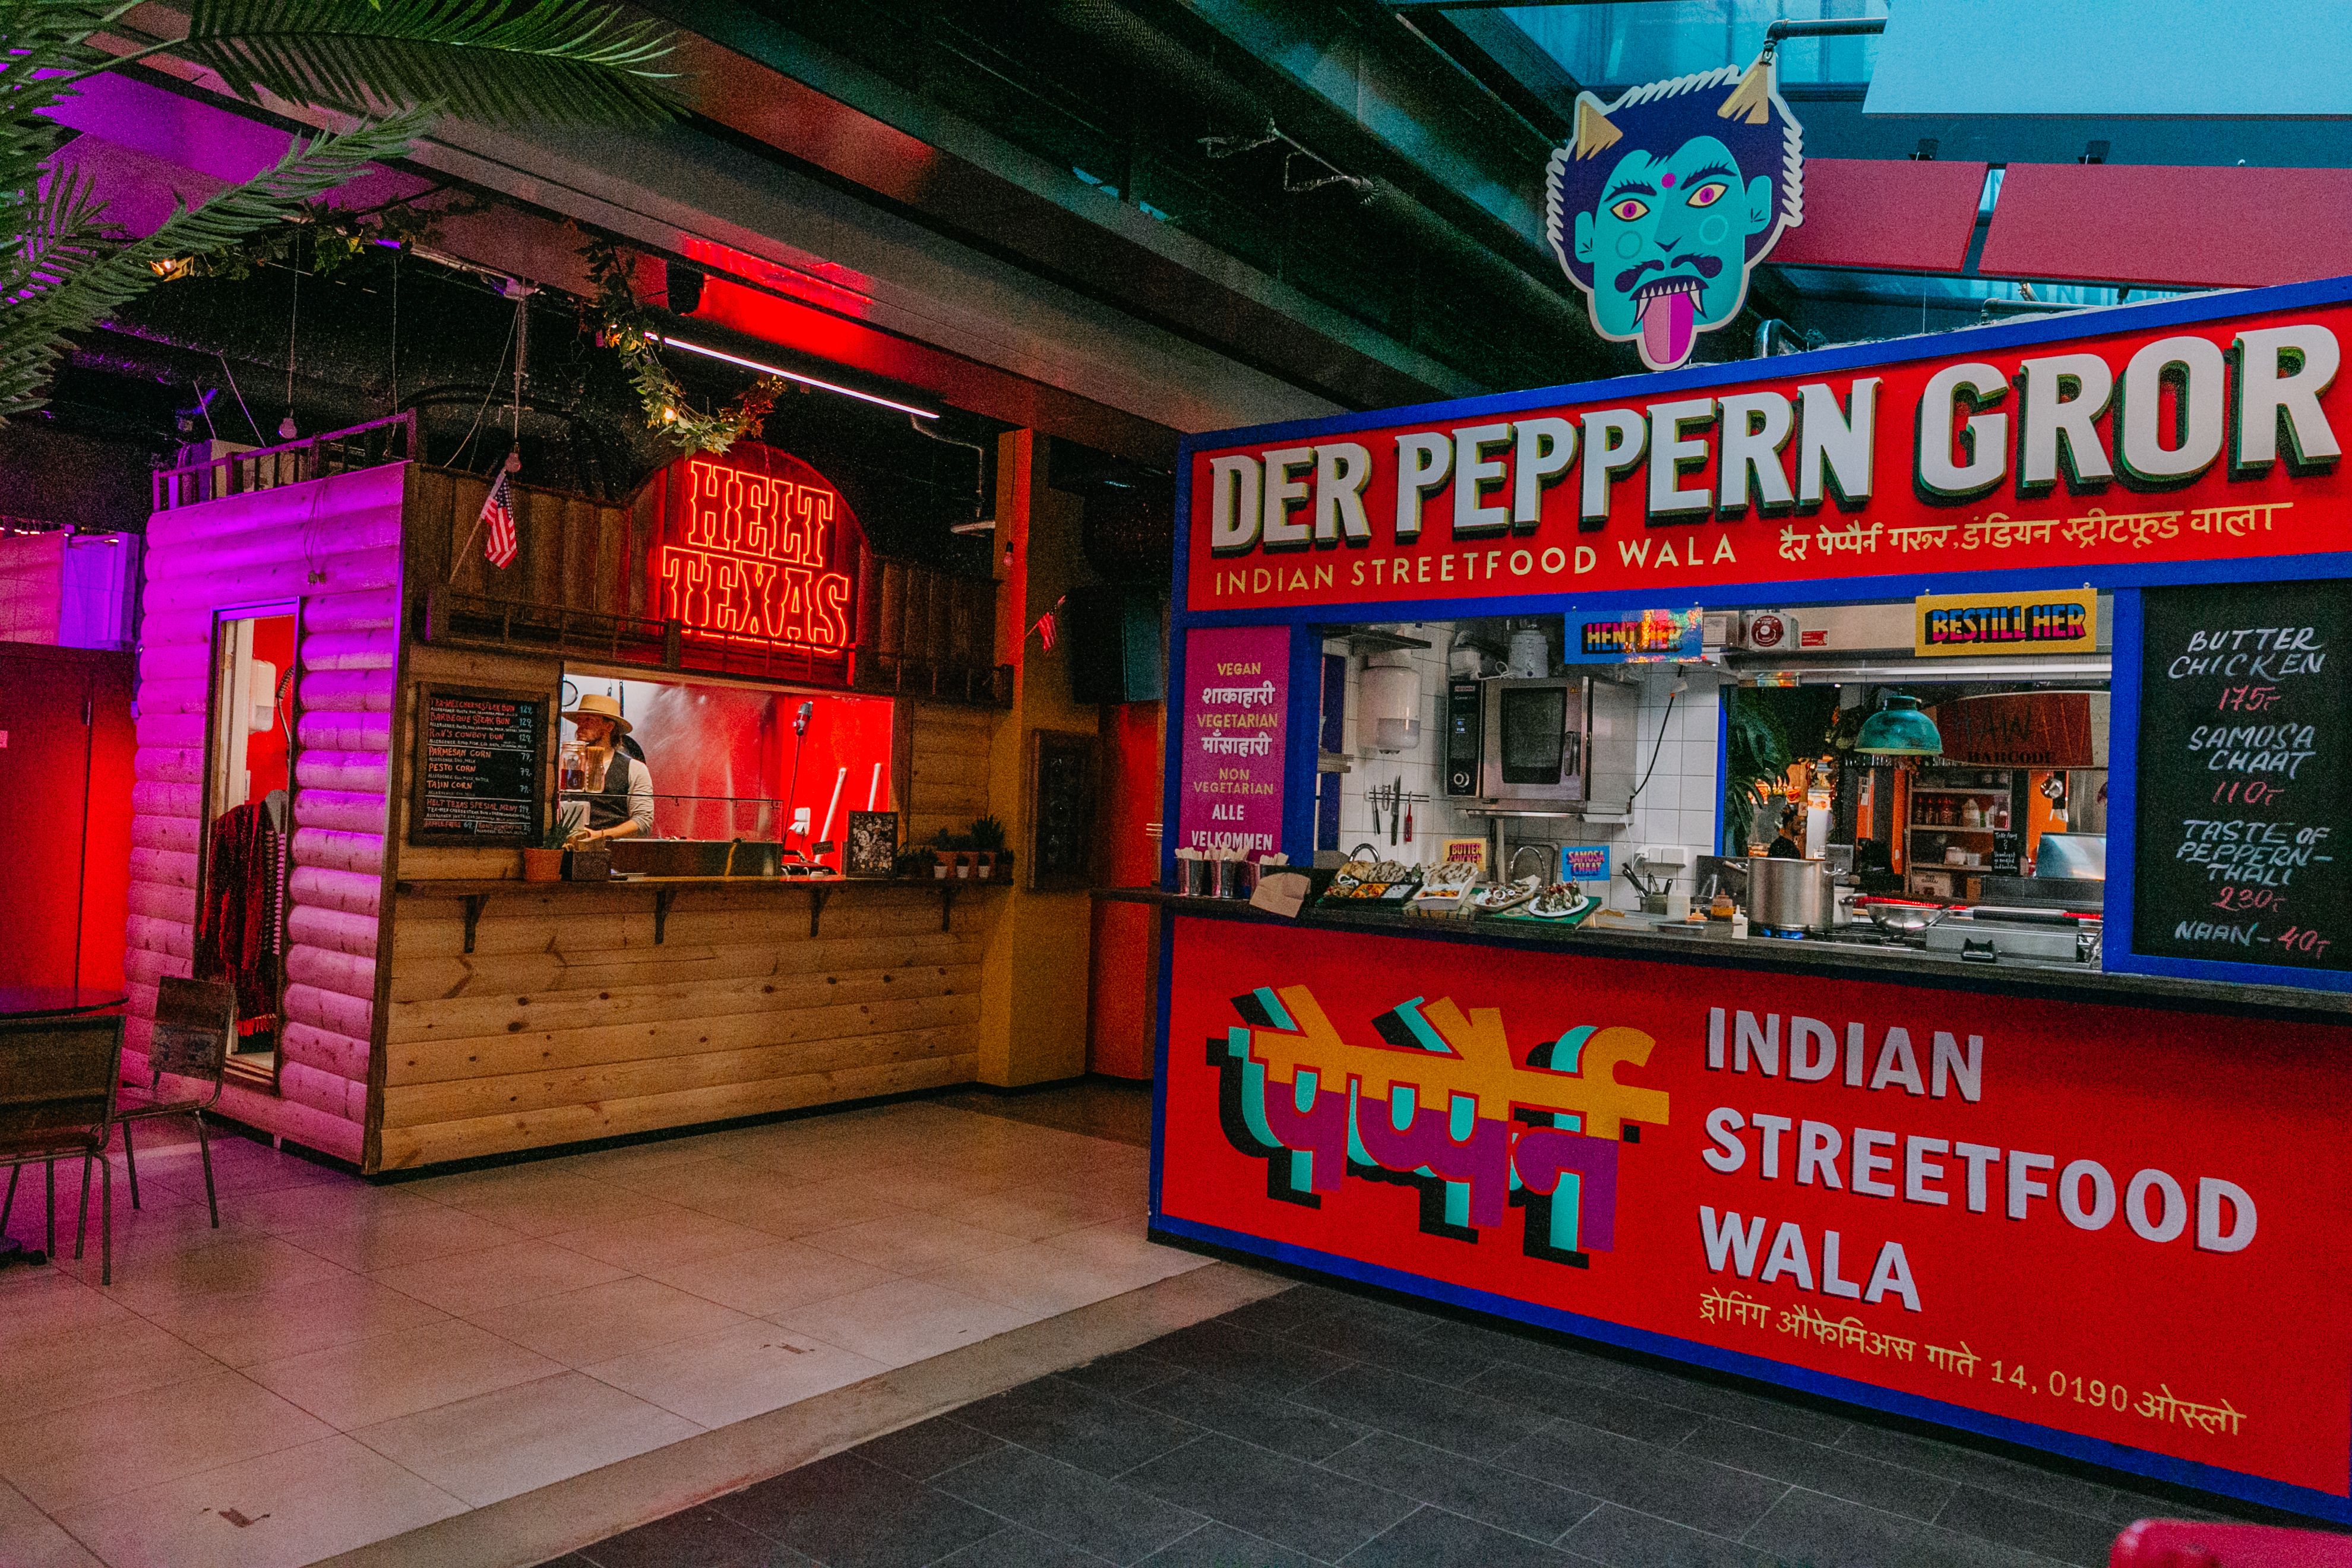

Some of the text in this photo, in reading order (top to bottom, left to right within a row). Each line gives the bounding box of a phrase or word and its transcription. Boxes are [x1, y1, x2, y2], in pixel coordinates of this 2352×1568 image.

[1210, 324, 2342, 554] DER PEPPERN GROR
[688, 461, 833, 567] HELT
[2191, 502, 2294, 537] वाला
[1216, 533, 1737, 596] INDIAN STREETFOOD WALA
[663, 546, 849, 653] TEXAS
[1928, 603, 2086, 644] BESTILL HER
[1583, 621, 1638, 653] HENT
[2187, 627, 2325, 653] BUTTER
[1217, 662, 1262, 676] VEGAN
[2168, 654, 2325, 682] CHICKEN
[1202, 680, 1276, 709] शाकाहारी
[429, 712, 471, 723] BARBEQUE
[472, 715, 494, 725] STEAK
[496, 717, 510, 725] BUN
[1197, 713, 1278, 728] VEGETARIAN
[455, 731, 486, 739] COWBOY
[2188, 723, 2315, 751] SAMOSA
[428, 746, 466, 757] PARMESAN
[470, 750, 492, 758] CORN
[2208, 750, 2316, 779] CHAAT
[428, 763, 453, 772] PESTO
[1219, 768, 1250, 781] NON
[1193, 781, 1274, 795] VEGETARIAN
[427, 798, 446, 807] HELT
[447, 799, 468, 808] TEXAS
[1212, 804, 1244, 821] ALLE
[1191, 830, 1273, 851] VELKOMMEN
[2182, 819, 2332, 846] TASTE OF
[1450, 843, 1482, 855] BUTTER
[1568, 850, 1605, 864] SAMOSA
[1572, 862, 1602, 874] CHAAT
[2207, 862, 2291, 887] THALI
[1705, 1006, 1984, 1103] INDIAN
[1701, 1107, 2258, 1254] STREETFOOD
[1698, 1205, 1923, 1312] WALA
[1924, 1341, 1981, 1379] गाते
[1991, 1360, 2037, 1395] 14,
[2048, 1370, 2128, 1412] 0190
[2133, 1383, 2247, 1436] ओस्लो
